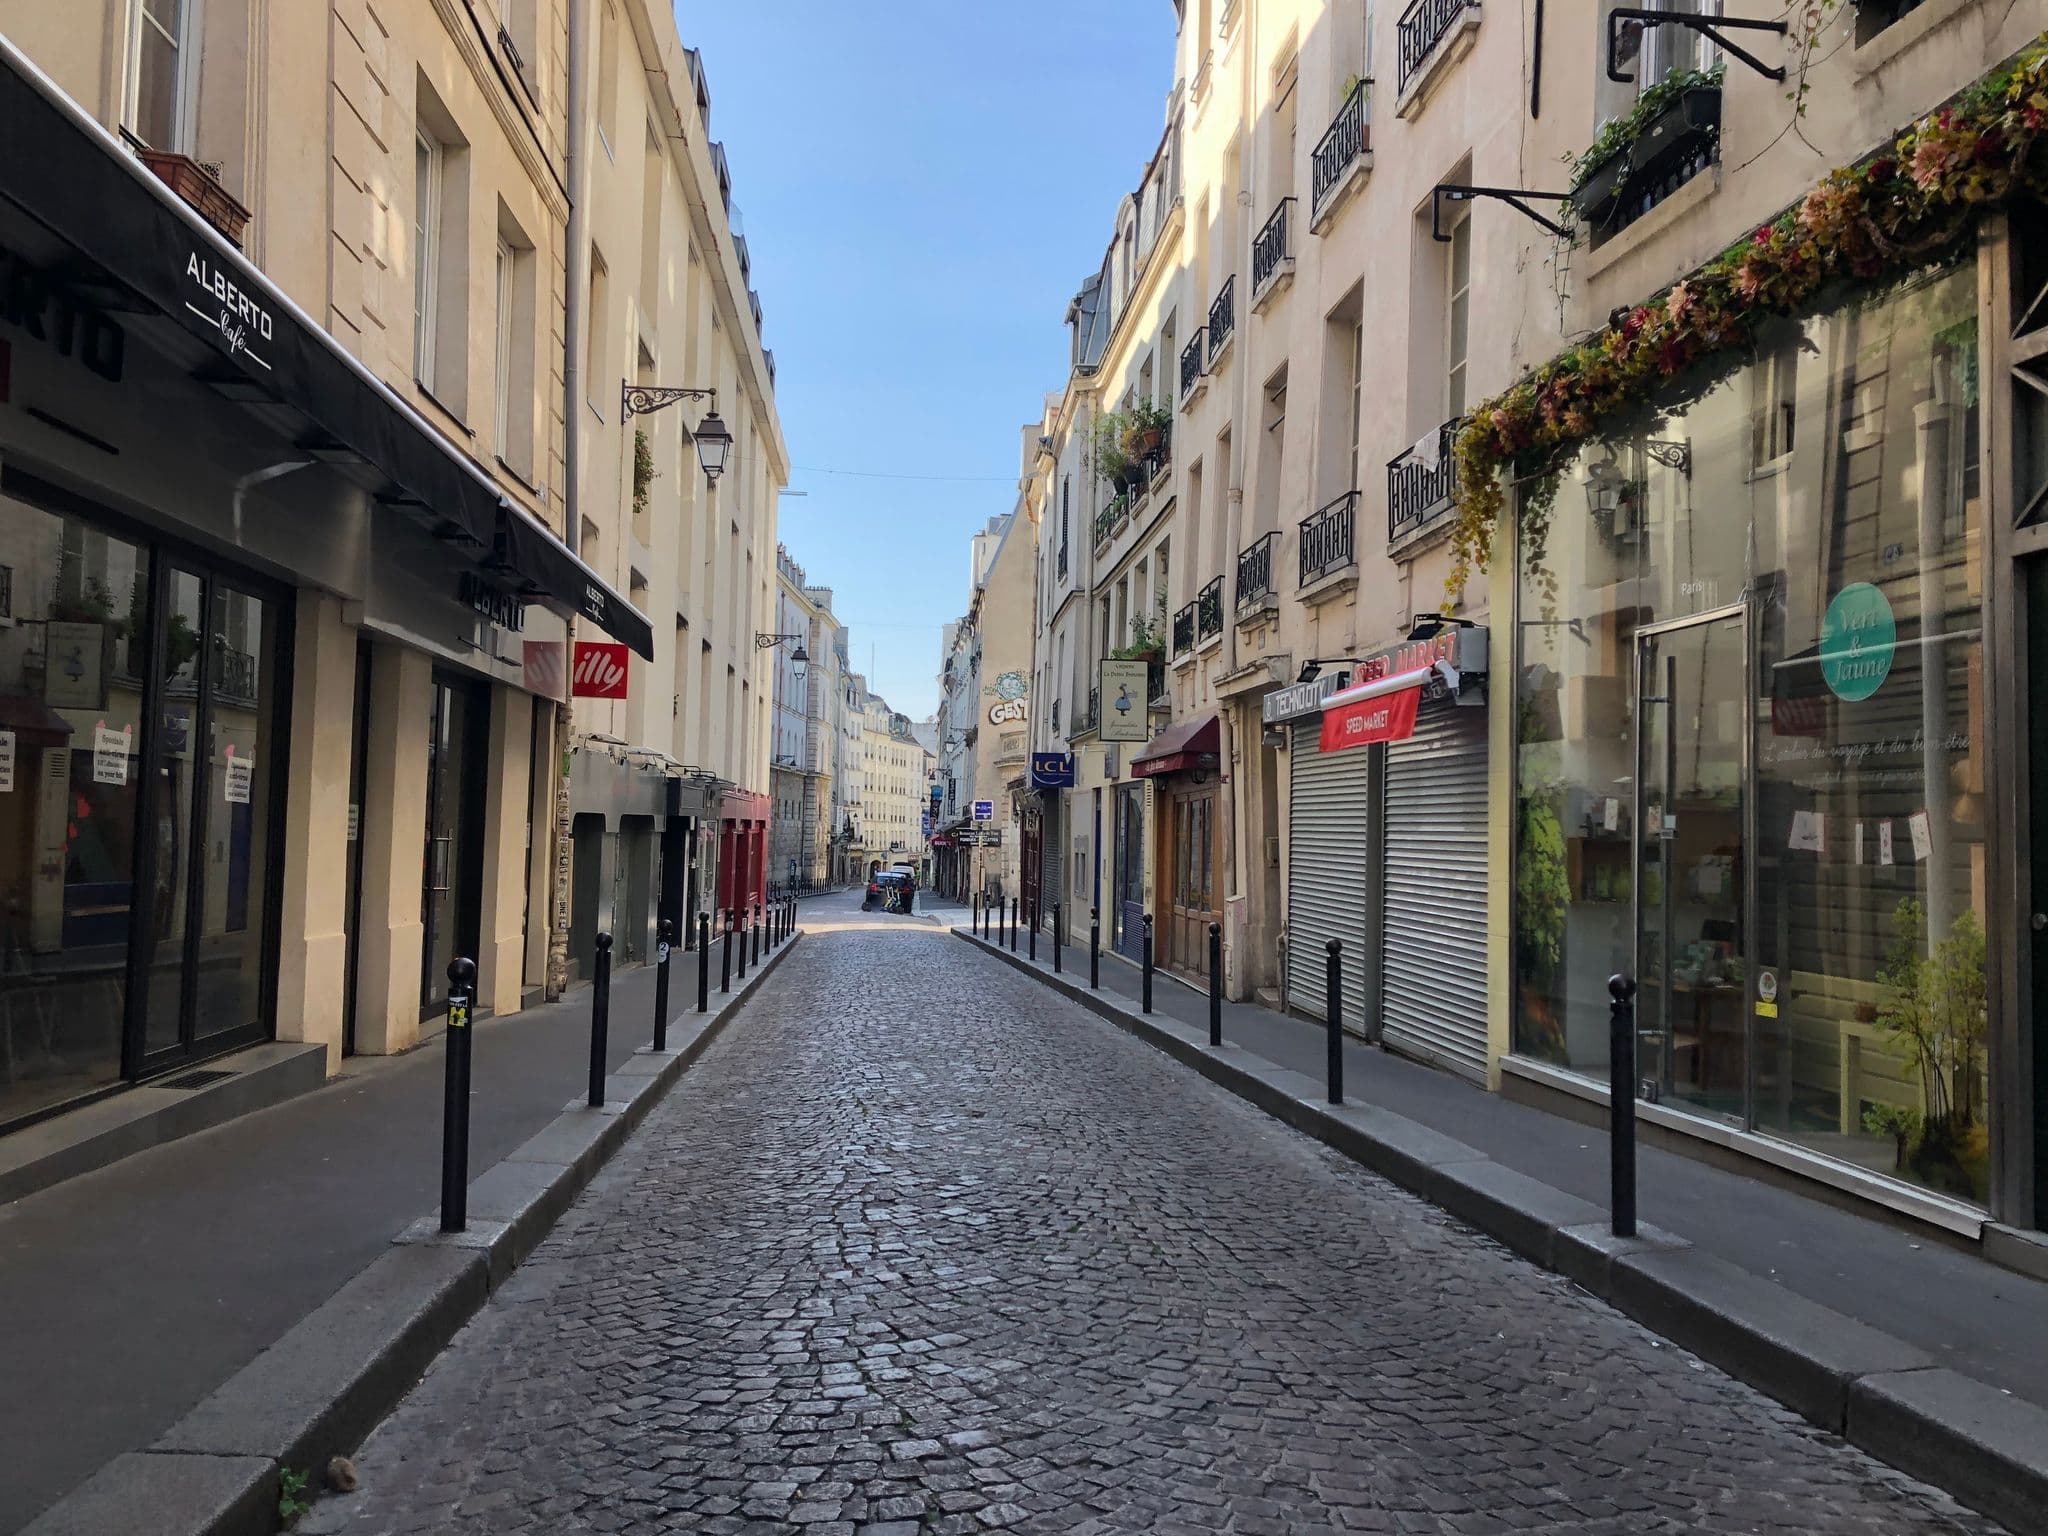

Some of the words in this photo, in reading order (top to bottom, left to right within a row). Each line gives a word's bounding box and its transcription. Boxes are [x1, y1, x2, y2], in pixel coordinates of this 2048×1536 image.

[187, 251, 272, 341] ALBERTO
[220, 309, 246, 353] Café
[1840, 608, 1880, 632] Vert
[1849, 635, 1863, 658] &
[574, 650, 624, 692] illy
[1832, 657, 1887, 686] Jaune
[1346, 715, 1363, 734] SPEED
[1364, 710, 1389, 731] MARKET
[1035, 760, 1070, 772] LCL
[660, 942, 666, 951] 2
